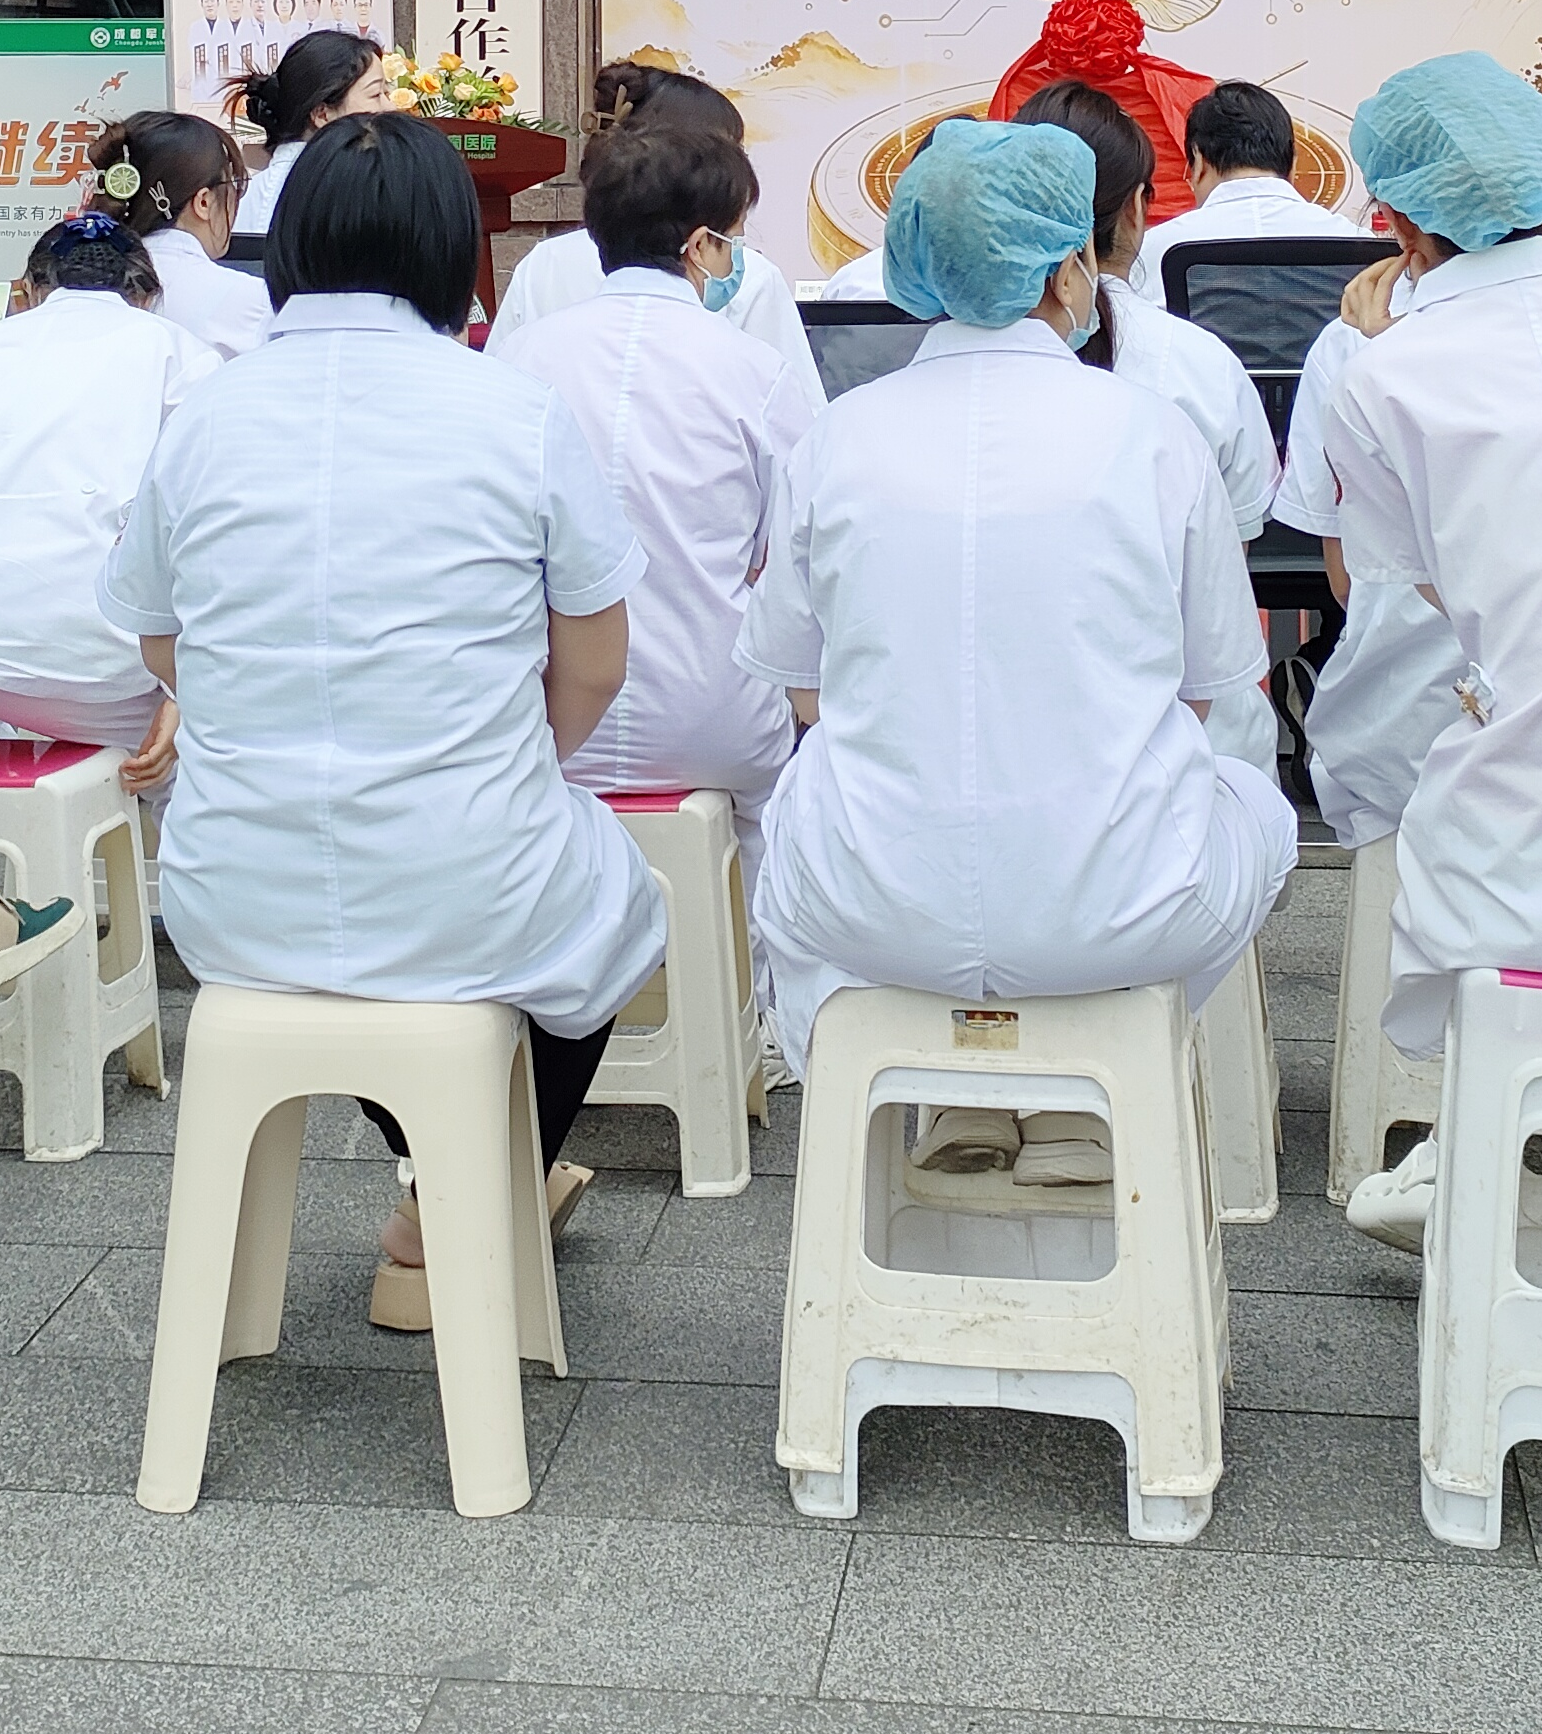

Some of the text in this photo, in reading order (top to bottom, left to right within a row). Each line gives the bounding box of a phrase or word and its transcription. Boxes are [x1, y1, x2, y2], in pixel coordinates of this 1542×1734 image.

[114, 28, 165, 40] 成都军
[467, 152, 496, 160] Hospital
